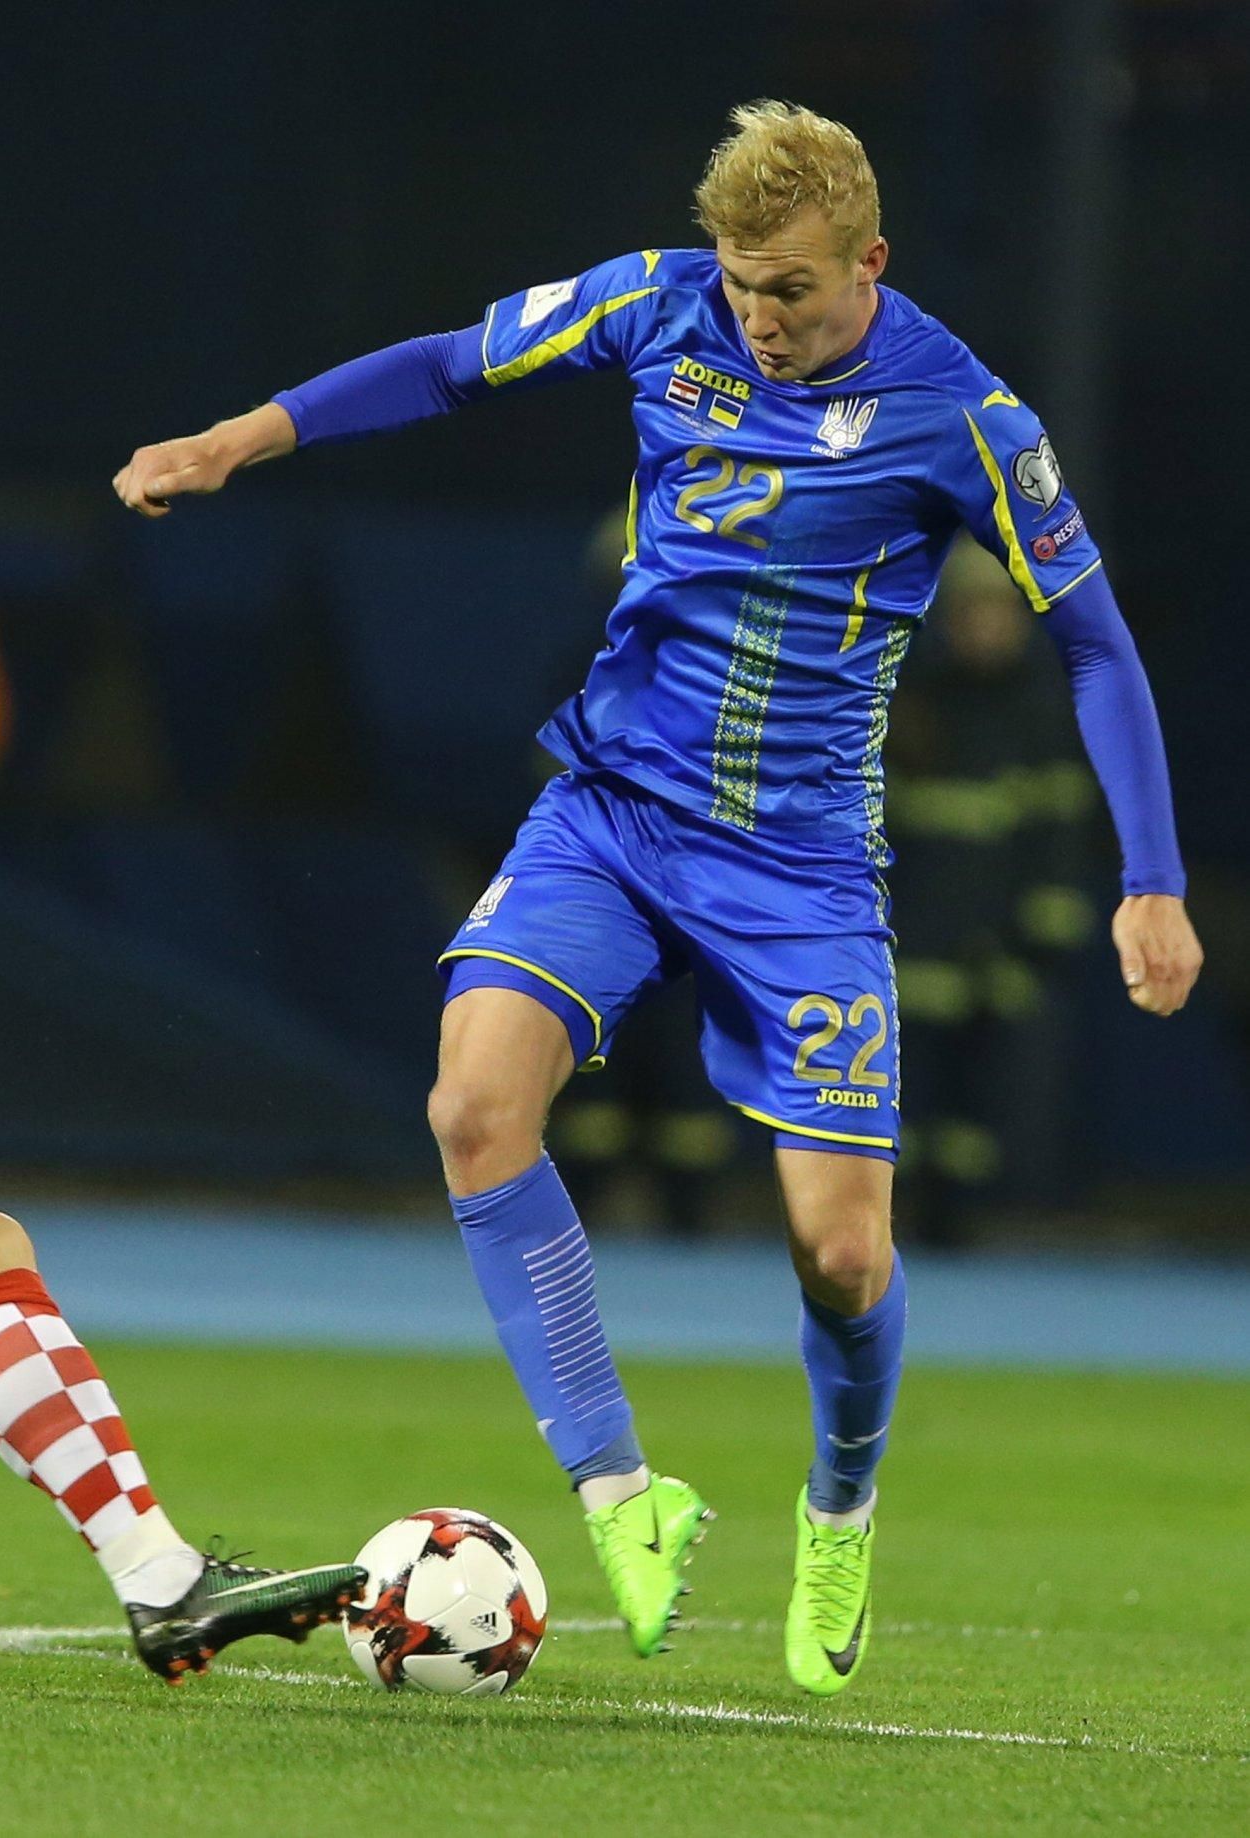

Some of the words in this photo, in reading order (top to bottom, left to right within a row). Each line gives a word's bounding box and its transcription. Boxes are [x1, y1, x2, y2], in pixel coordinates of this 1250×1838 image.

[673, 356, 751, 401] Joma
[810, 444, 852, 460] UKRAIN
[673, 445, 784, 549] 22
[787, 993, 889, 1087] 22
[815, 1087, 879, 1109] Joma
